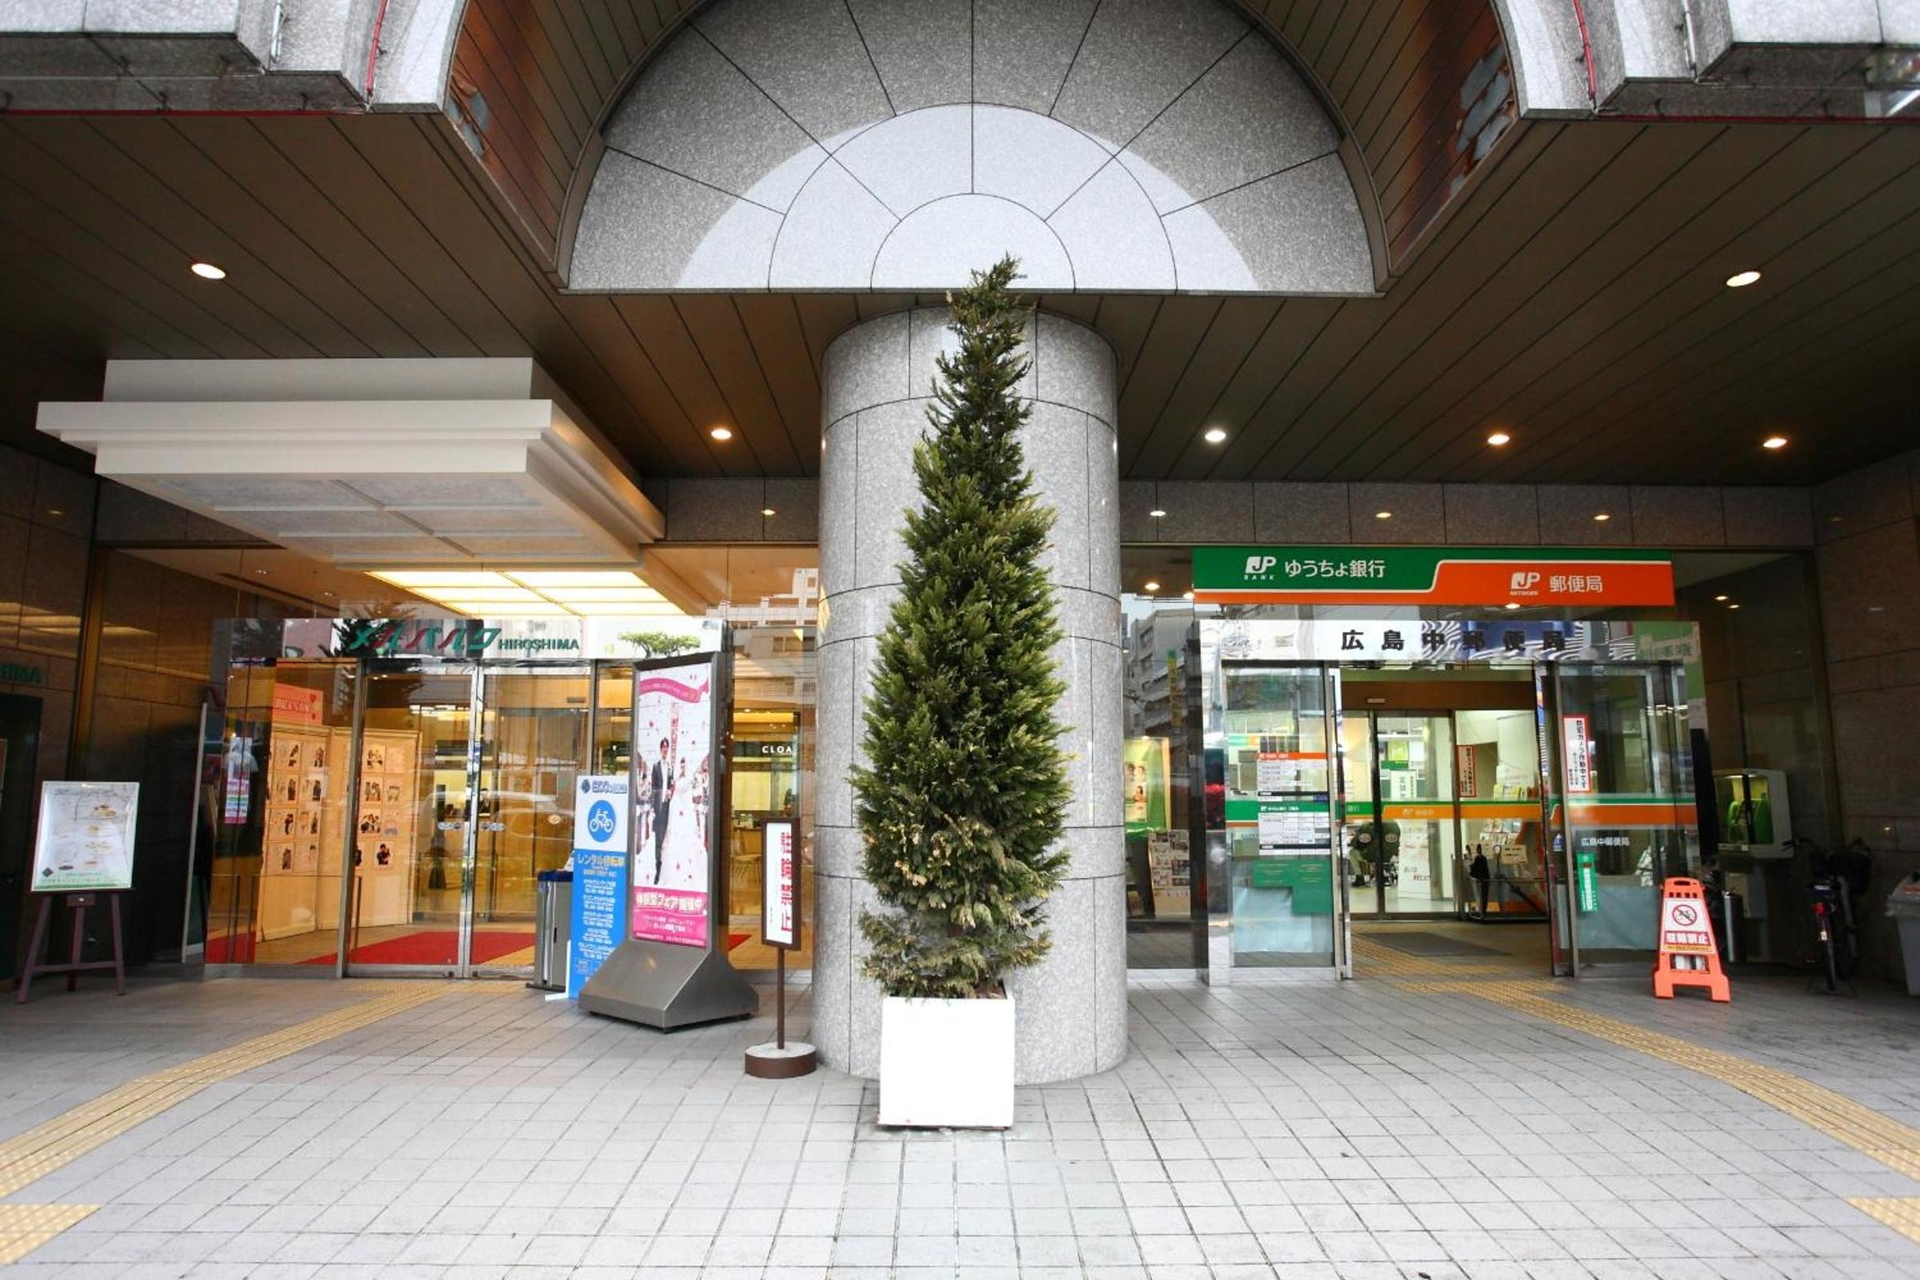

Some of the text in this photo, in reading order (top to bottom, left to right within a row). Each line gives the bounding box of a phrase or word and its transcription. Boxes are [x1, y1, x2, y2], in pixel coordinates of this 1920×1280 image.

[1245, 556, 1277, 574] JP
[1284, 560, 1386, 578] ゆうちょ銀行
[1510, 571, 1540, 590] JP
[1549, 575, 1603, 593] 郵便局
[349, 627, 579, 650] メルパルク HIROSHIMA
[1341, 629, 1566, 651] 広島中郵便局
